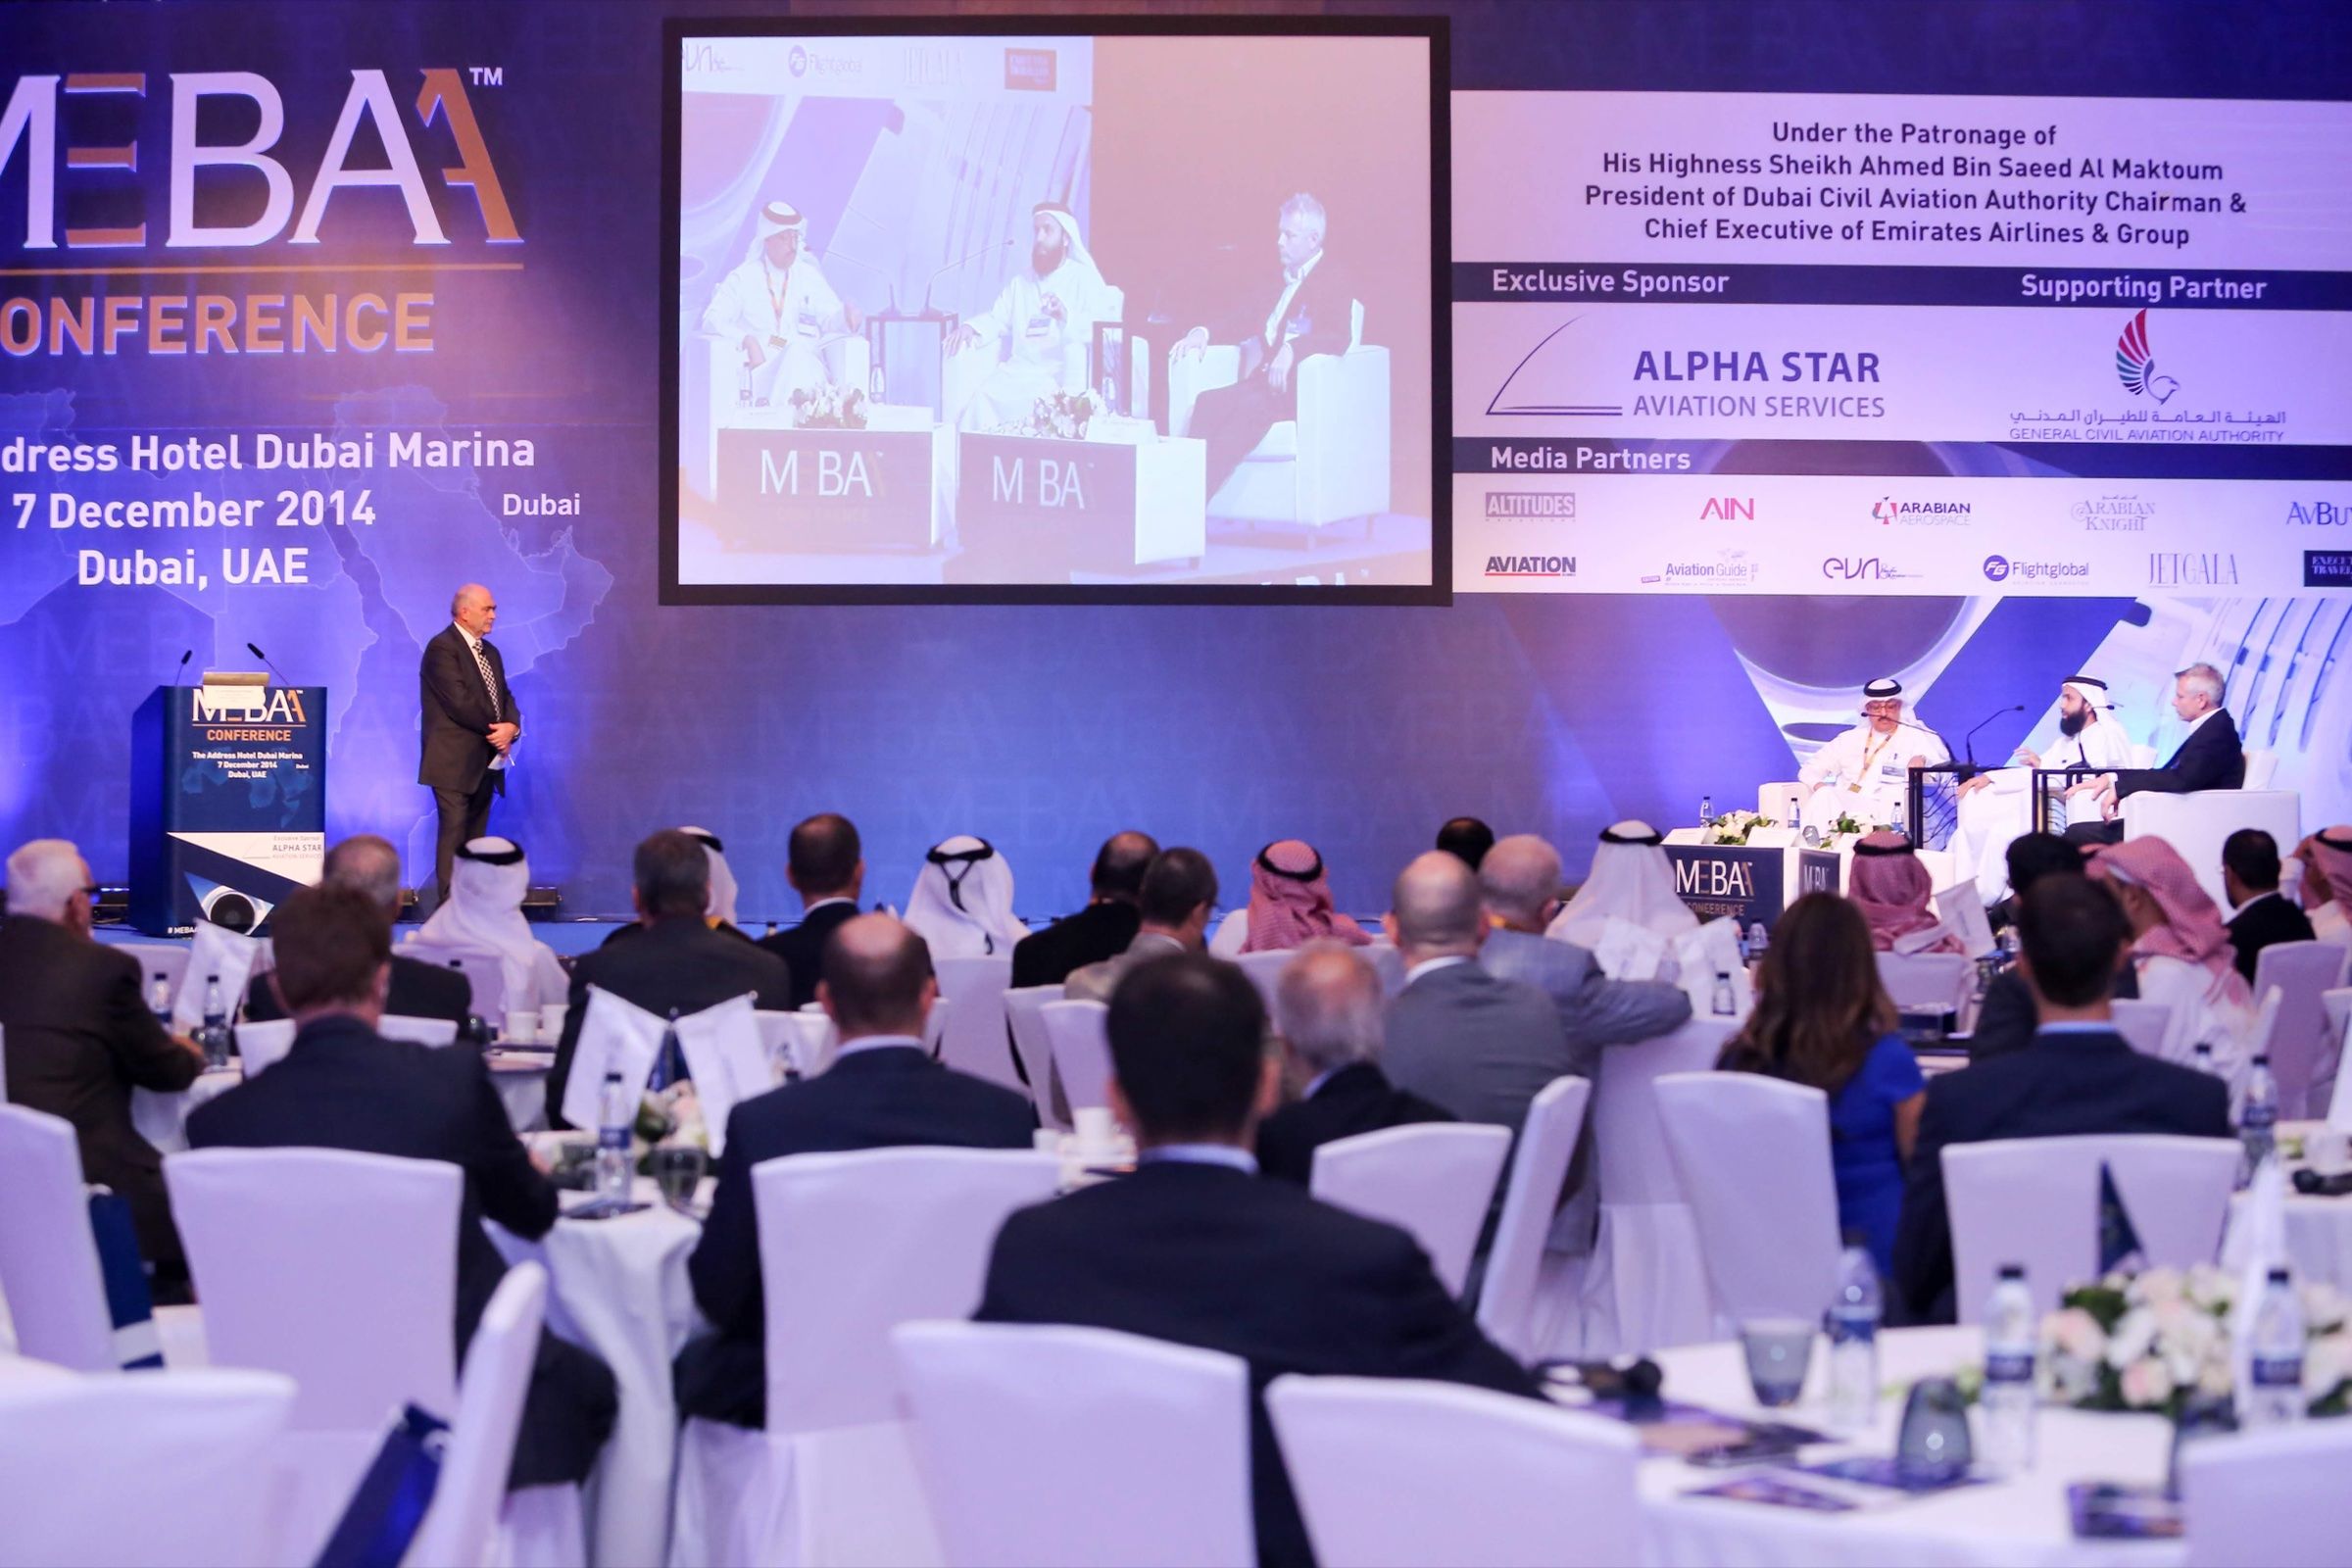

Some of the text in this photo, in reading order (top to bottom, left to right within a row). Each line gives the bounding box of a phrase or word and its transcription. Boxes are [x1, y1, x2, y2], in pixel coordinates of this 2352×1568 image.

[1773, 122, 2056, 149] Under the Patronage of
[1603, 153, 2223, 180] His Highness Sheikh Ahmed Bin Saeed Al Maktoum
[1586, 184, 2246, 216] President of Dubai Civil Aviation Authority Chairman &
[1645, 218, 2189, 249] Chief Executive of Emirates Airlines & Group
[1493, 269, 1730, 297] Exclusive Sponsor
[2021, 273, 2268, 303] Supporting Partner
[0, 293, 434, 357] ONFERENCE
[1633, 350, 1881, 382] ALPHA STAR
[1633, 395, 1886, 417] AVIATION SERVICES
[2010, 427, 2284, 442] GENERAL CIVIL AVIATION AUTHORITY
[0, 431, 535, 472] dress Hotel Dubai Marina
[1492, 446, 1690, 470] Media Partners
[13, 489, 376, 529] 7 December 2014
[503, 493, 581, 517] Dubai
[1488, 494, 1574, 515] ALTITUDES
[1699, 497, 1754, 520] AIN
[1900, 502, 1971, 514] ARABIAN
[1900, 514, 1971, 526] AEROSPACE
[78, 547, 309, 591] Dubai, UAE
[1486, 556, 1577, 573] AVIATION
[1666, 562, 1714, 576] Aviation
[1716, 563, 1747, 576] Guide
[2013, 562, 2089, 579] Flightglobal
[207, 729, 292, 742] CONFERENCE
[192, 751, 206, 760] The
[218, 760, 277, 769] 7 December 2014
